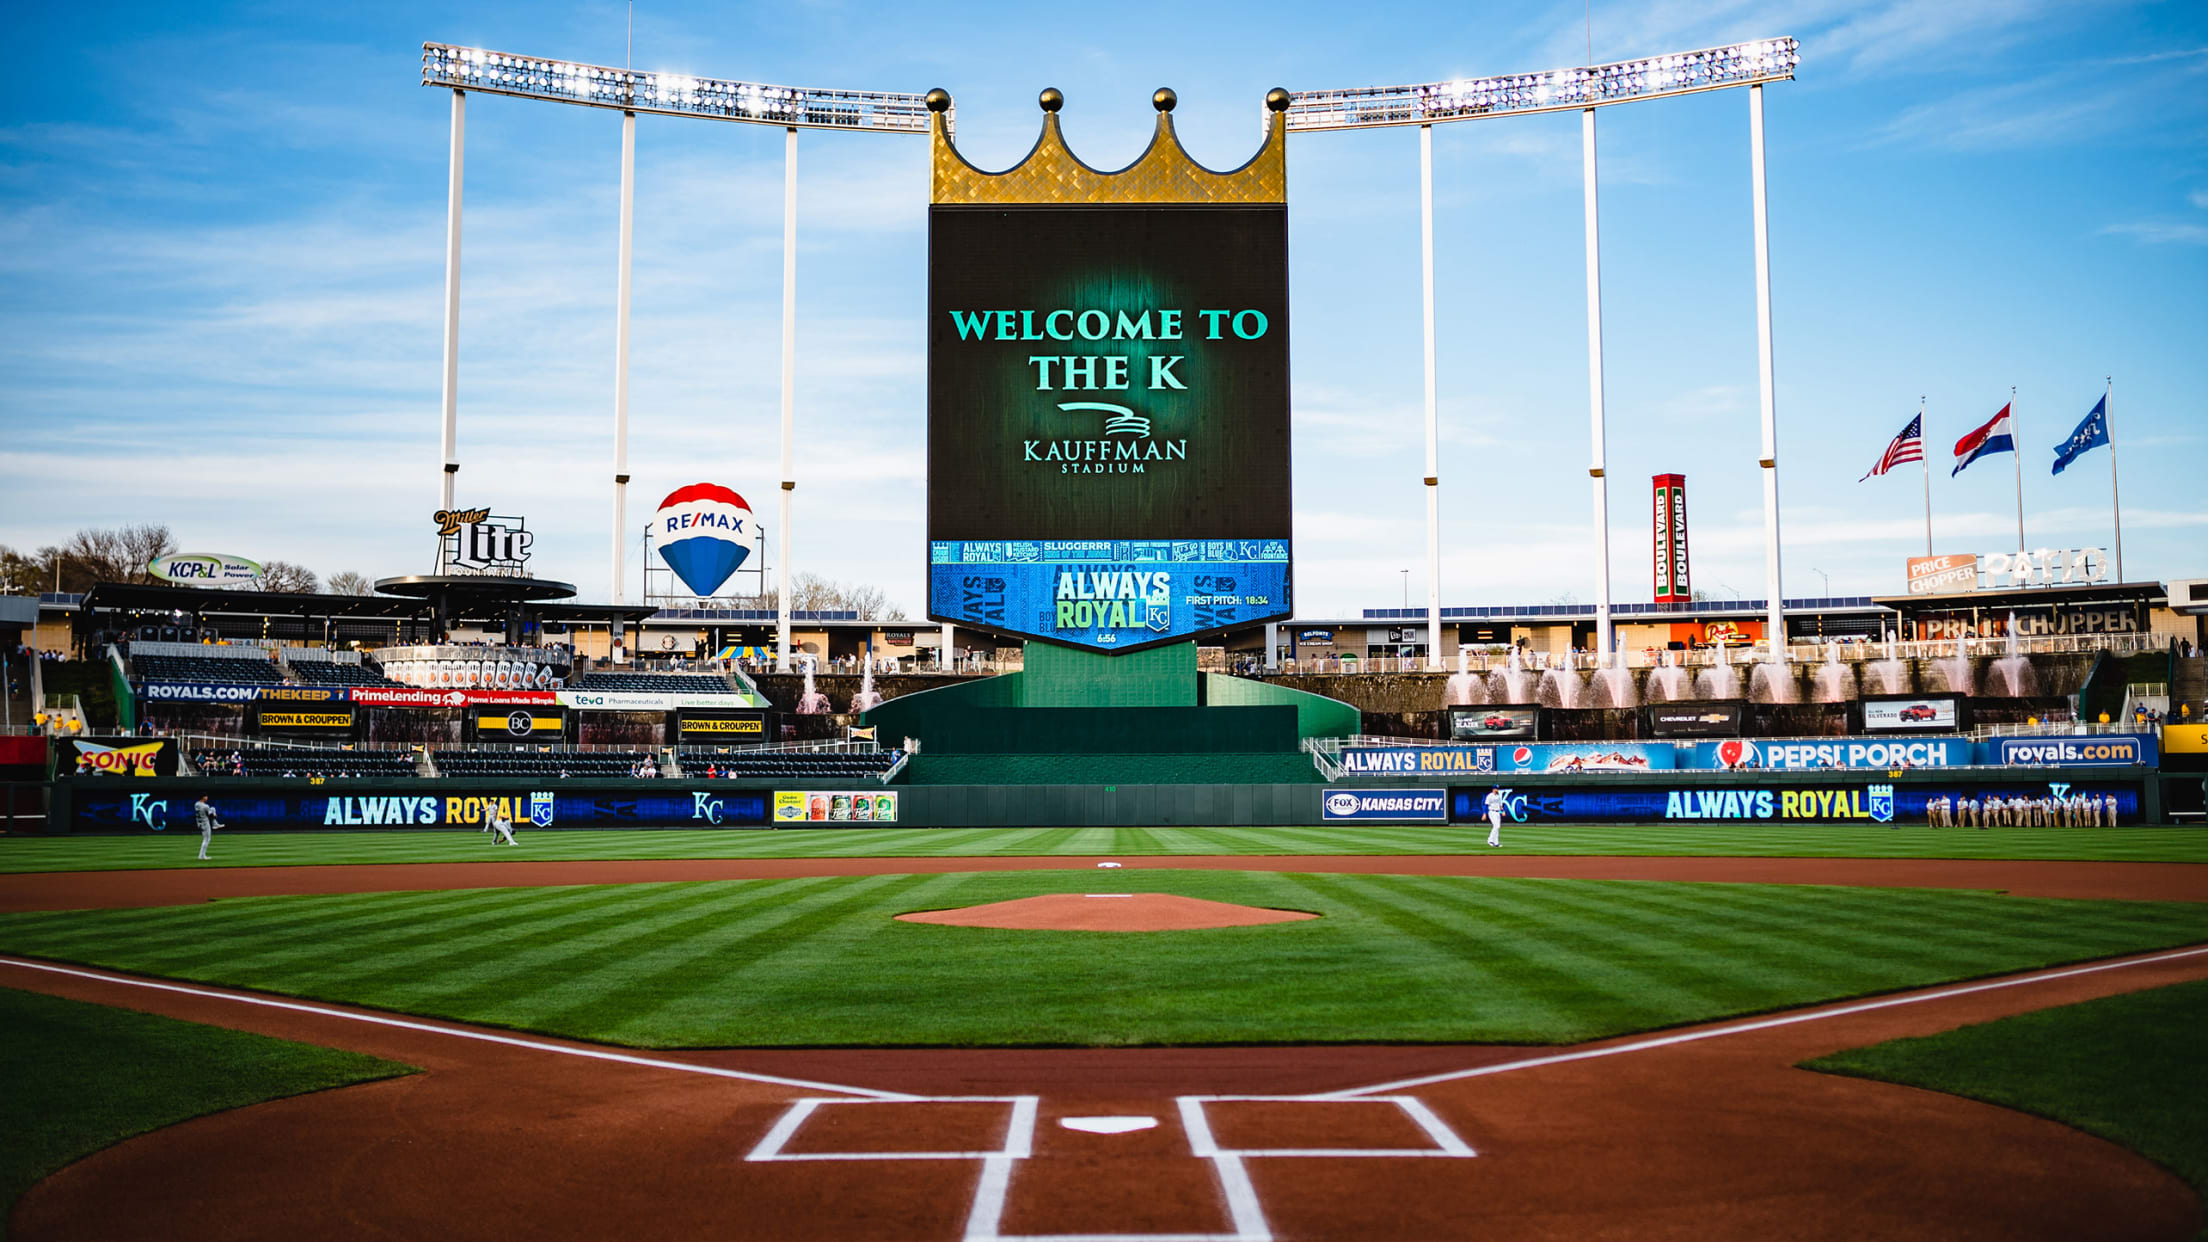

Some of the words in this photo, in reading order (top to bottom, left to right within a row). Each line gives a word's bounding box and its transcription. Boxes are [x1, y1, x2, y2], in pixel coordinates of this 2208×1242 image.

[949, 309, 1184, 341] WELCOME
[1198, 309, 1269, 340] TO
[1028, 356, 1131, 391] THE
[1147, 355, 1188, 391] K
[1023, 440, 1187, 461] KAUFFMAN
[1061, 463, 1145, 474] STADIUM
[435, 510, 488, 535] Miller
[667, 512, 744, 534] RE/MAX
[454, 522, 533, 569] Lite
[963, 542, 1002, 552] ALWAYS
[1044, 542, 1111, 551] SLUGGERRR
[1207, 542, 1224, 550] BOYS
[1240, 541, 1257, 560] KC
[1656, 495, 1668, 587] BOULEVARD
[1675, 495, 1688, 587] BOULEVARD
[963, 553, 993, 562] ROYAL
[1207, 550, 1223, 558] BLUE
[168, 561, 217, 579] KCP&L
[1911, 556, 1951, 577] PRICE
[1984, 548, 2107, 587] PATIO
[1056, 571, 1170, 600] ALWAYS
[1910, 567, 1975, 594] CHOPPER
[1186, 596, 1212, 605] FIRST
[1213, 596, 1242, 605] PITCH:
[1245, 596, 1269, 605] 18:34
[1056, 600, 1146, 629] ROYAL
[1149, 607, 1168, 624] KC
[1097, 634, 1116, 643] 6:56
[1304, 630, 1329, 638] BELFONTE
[147, 685, 331, 701] ROYALS.COM/THEKEEP
[352, 690, 441, 704] PrimeLending
[532, 697, 555, 705] Simple
[575, 694, 604, 705] teva
[608, 697, 664, 705] Pharmaceuticals
[261, 715, 295, 724] BROWN
[295, 715, 302, 724] &
[304, 715, 349, 724] CROUPPEN
[511, 716, 529, 729] BC
[681, 721, 711, 730] BROWN
[712, 721, 718, 730] &
[719, 721, 760, 730] CROUPPEN
[80, 750, 157, 770] SONIC
[1344, 752, 1415, 771] ALWAYS
[1420, 752, 1477, 770] ROYAL
[1479, 756, 1491, 769] KC
[1768, 744, 1841, 767] PEPSI
[1849, 743, 1946, 767] PORCH
[2008, 742, 2133, 768] royals.com
[130, 793, 167, 831] KC
[324, 797, 437, 825] ALWAYS
[446, 797, 531, 825] ROYAL
[534, 803, 550, 821] KC
[692, 791, 724, 825] KC
[1333, 798, 1353, 808] FOX
[1361, 797, 1414, 811] KANSAS
[1498, 789, 1528, 823] KC
[1665, 791, 1773, 818] ALWAYS
[1781, 791, 1870, 818] ROYAL
[1872, 798, 1890, 815] KC
